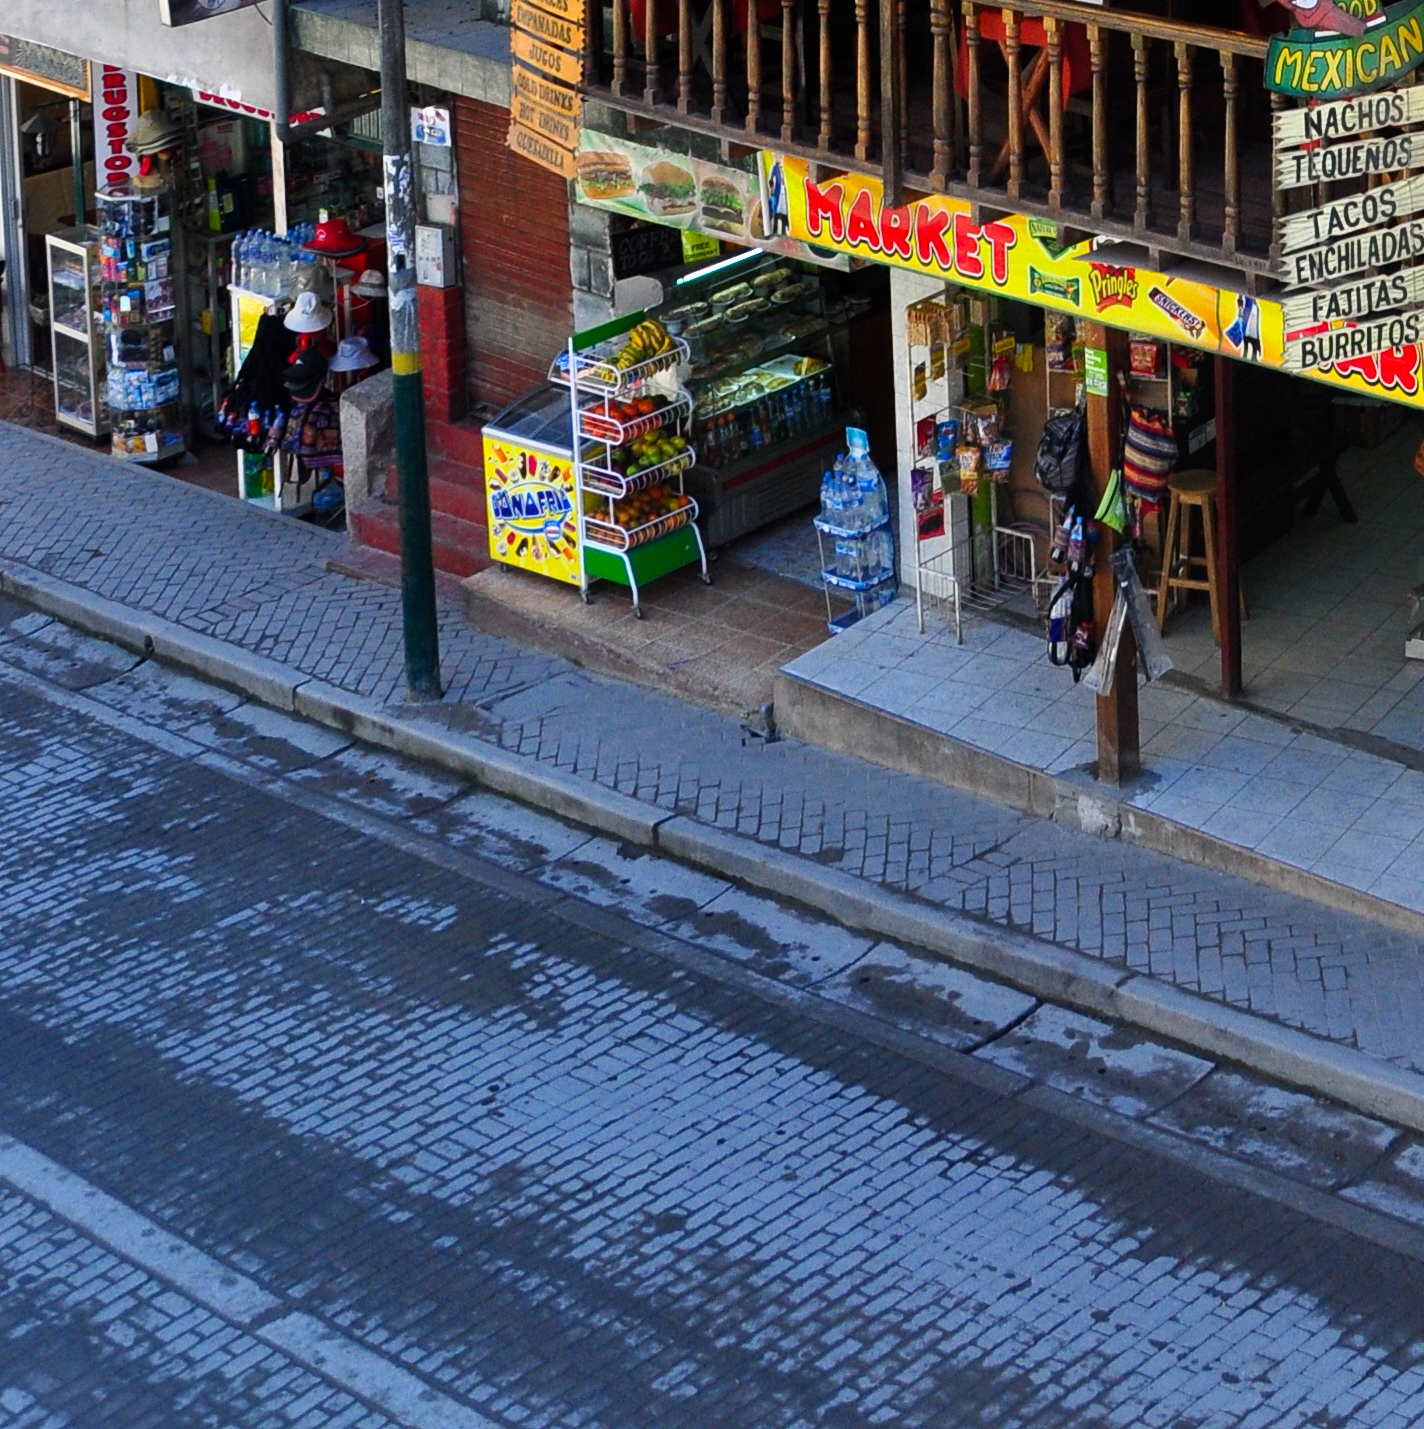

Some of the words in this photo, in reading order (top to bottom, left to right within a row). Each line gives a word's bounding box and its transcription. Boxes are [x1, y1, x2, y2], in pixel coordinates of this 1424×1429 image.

[528, 44, 562, 72] JUGOS
[1275, 18, 1424, 92] MEXICAN
[538, 82, 574, 112] DRINKS
[1292, 137, 1411, 184] TEQUEÑOS
[804, 176, 1016, 283] MARKET
[1307, 189, 1397, 239] TACOS
[691, 242, 711, 251] FREE
[1089, 269, 1139, 304] Pringles
[1155, 293, 1198, 326] SNICKERS
[1312, 275, 1408, 323] FAJITAS
[1301, 313, 1420, 368] BURRITOS
